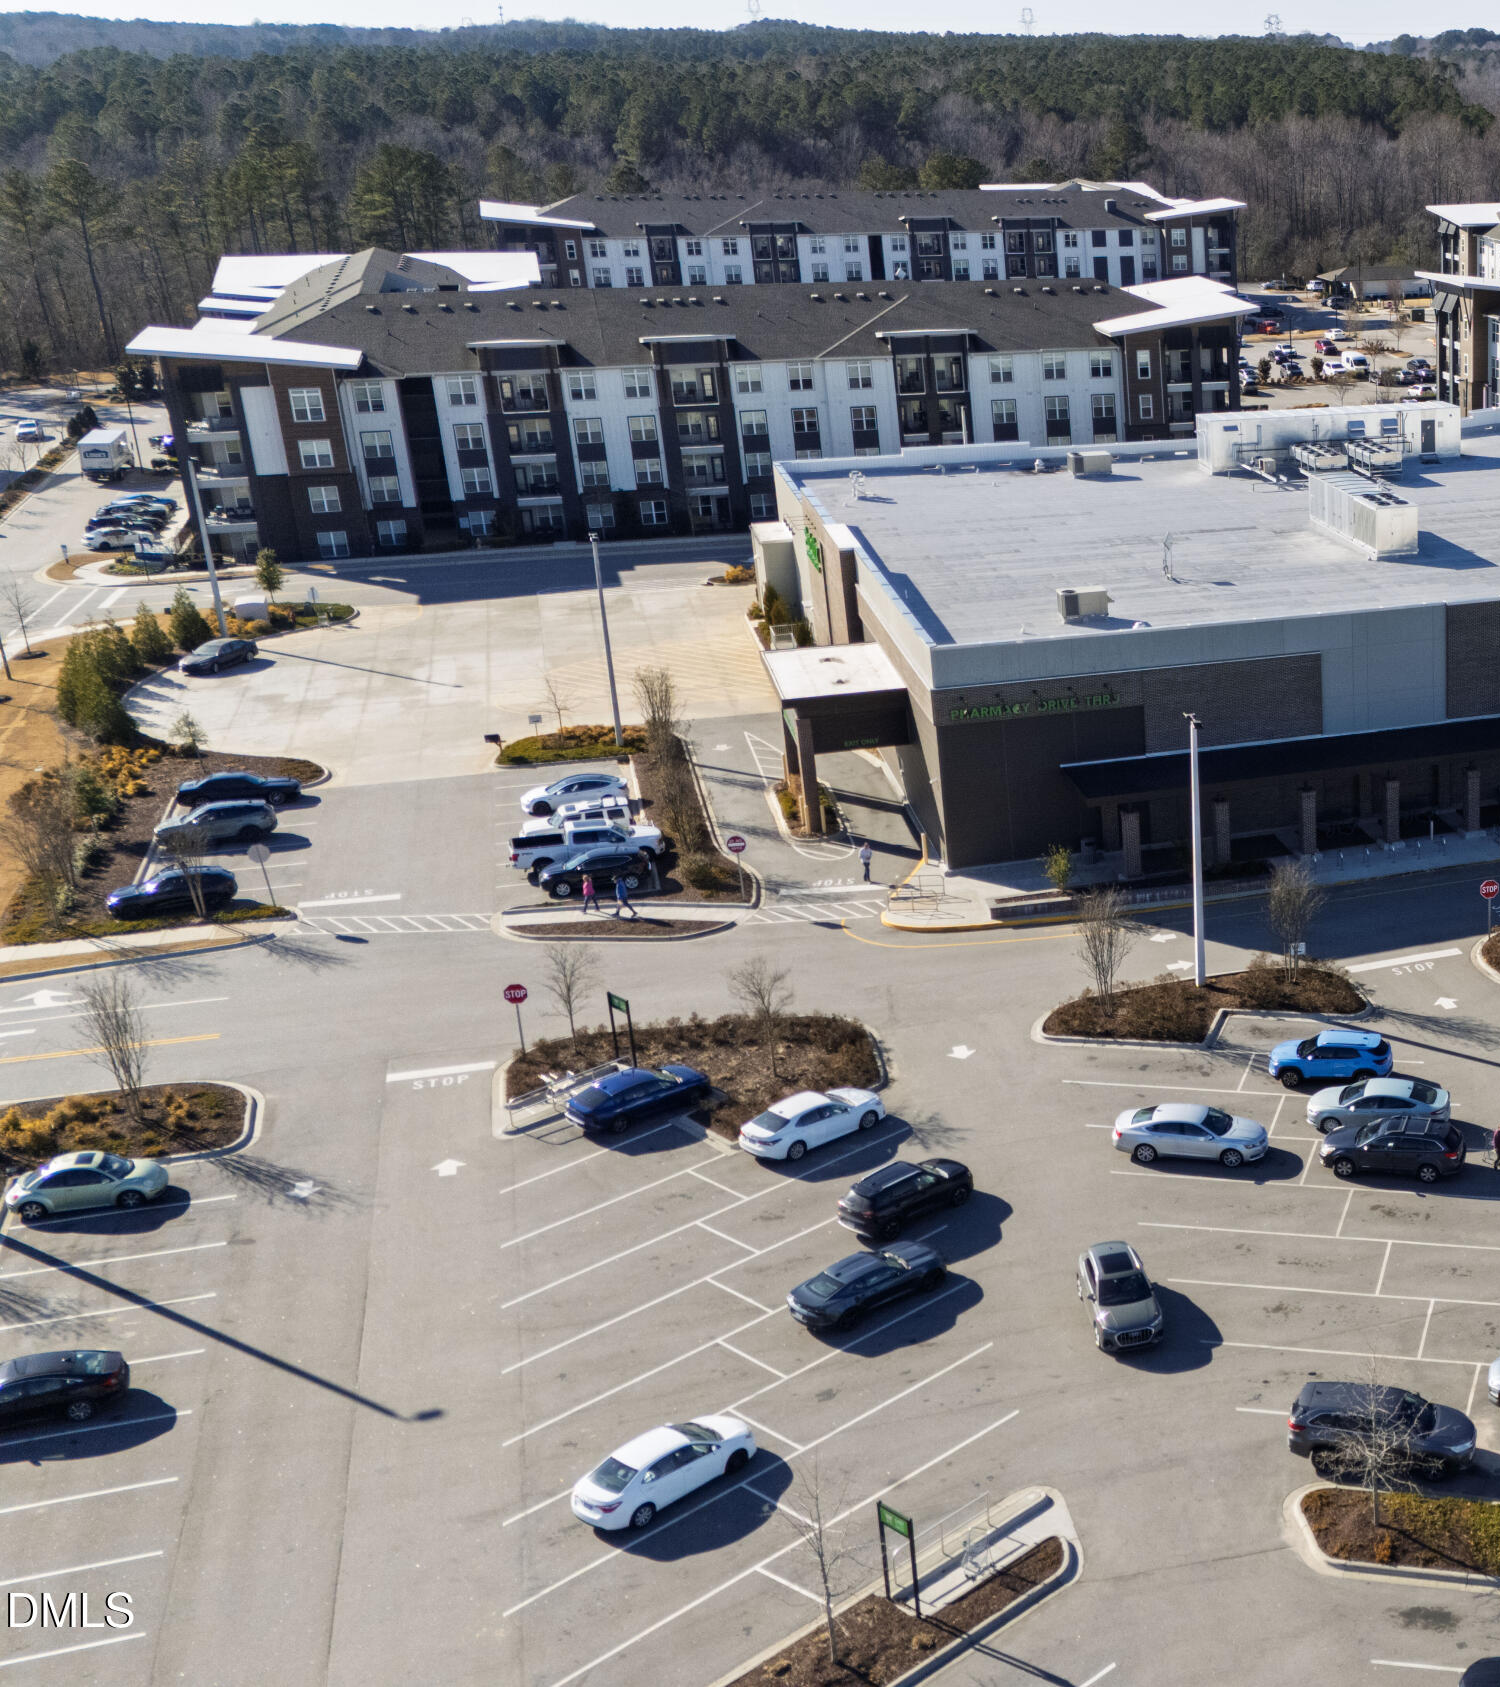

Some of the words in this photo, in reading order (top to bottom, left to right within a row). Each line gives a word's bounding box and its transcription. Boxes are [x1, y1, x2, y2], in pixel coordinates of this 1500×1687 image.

[951, 702, 1030, 721] PHARMACY
[1038, 698, 1078, 712] DRIVE
[1481, 885, 1498, 894] STOP
[1391, 961, 1435, 976] STOP
[505, 990, 528, 999] STOP
[412, 1074, 469, 1090] STOP
